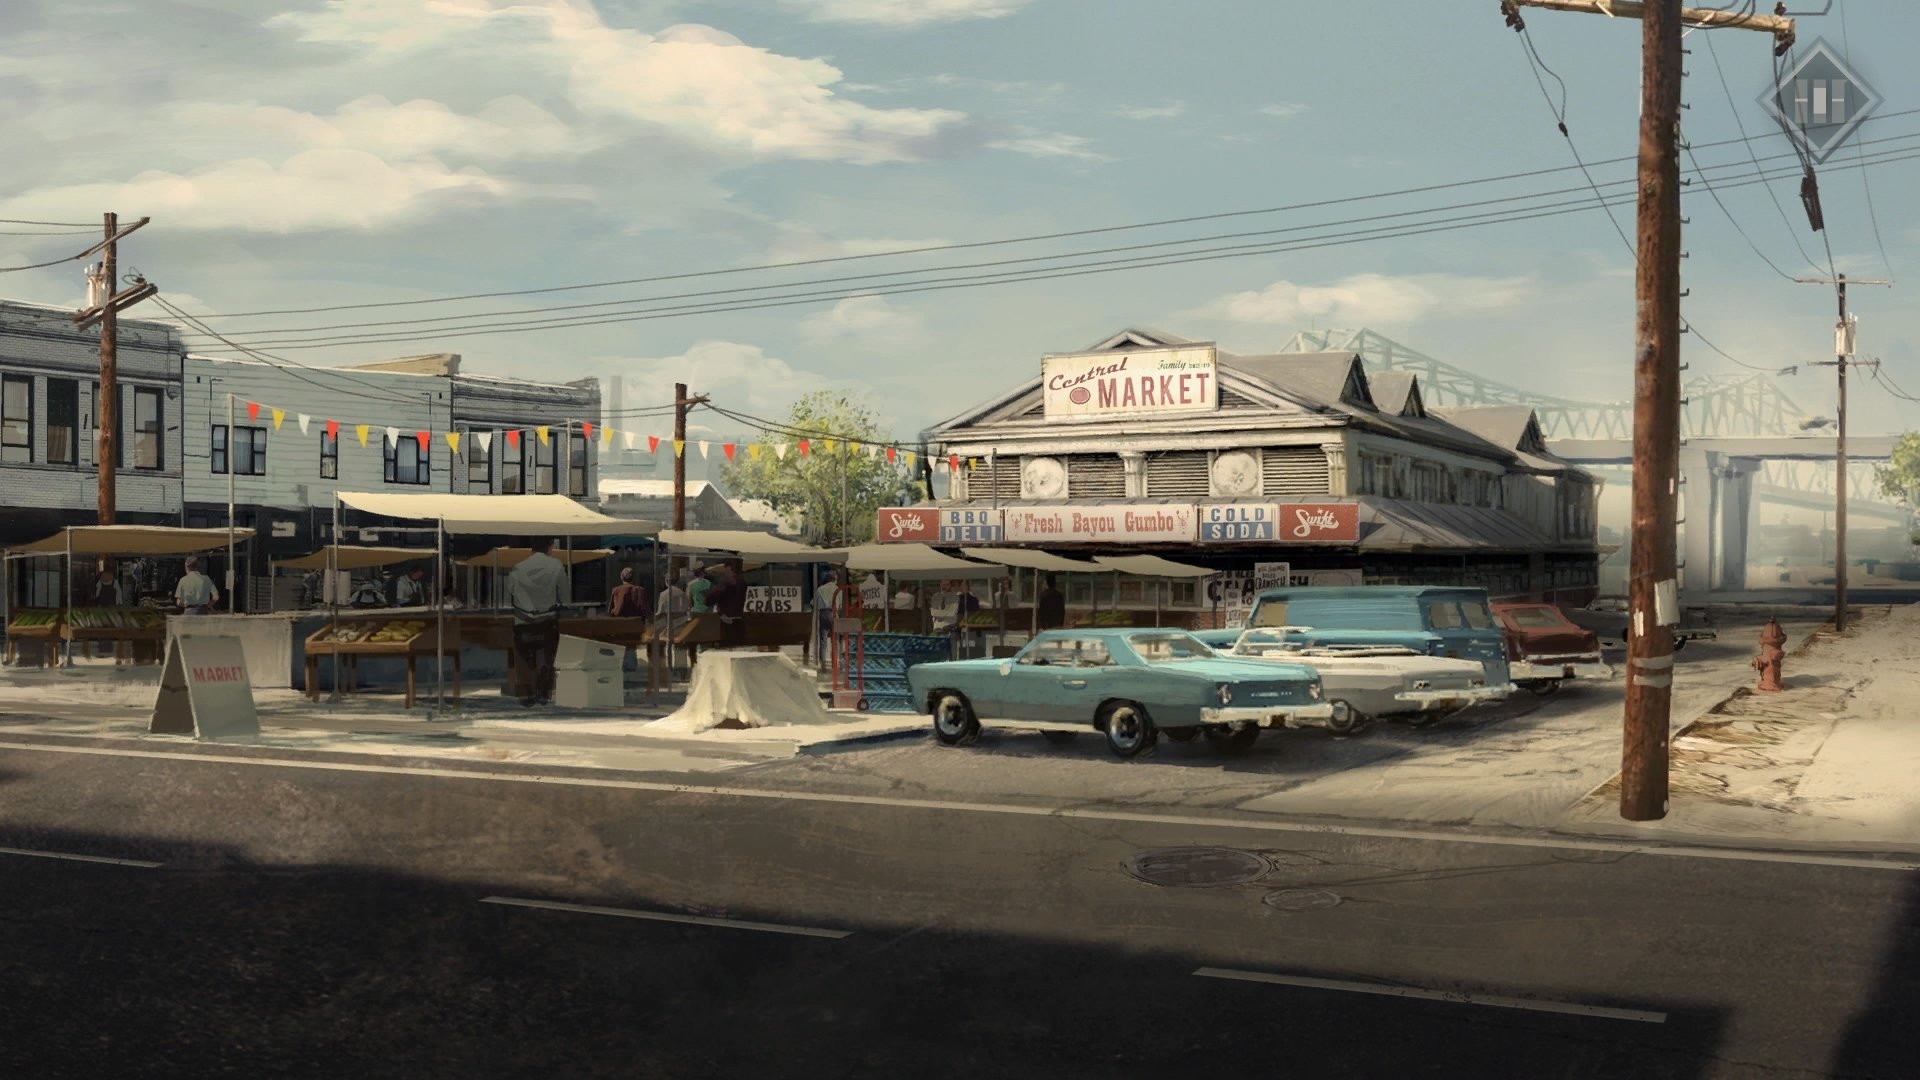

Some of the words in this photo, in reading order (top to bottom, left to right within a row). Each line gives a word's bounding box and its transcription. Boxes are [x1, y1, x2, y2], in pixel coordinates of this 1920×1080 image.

[1049, 356, 1127, 390] Central
[1157, 359, 1187, 371] Family
[1097, 373, 1209, 408] MARKET
[951, 510, 988, 525] BBQ
[1211, 507, 1264, 522] COLD
[1293, 507, 1340, 538] Swift
[889, 513, 924, 538] Swift
[1025, 513, 1063, 533] Fresh
[1072, 512, 1115, 537] Bayou
[1125, 510, 1174, 533] Gumbo
[1211, 523, 1265, 540] SODA
[945, 526, 997, 542] DELI
[764, 587, 798, 598] BOILED
[746, 599, 792, 612] CRABS
[193, 667, 243, 681] MARKET
